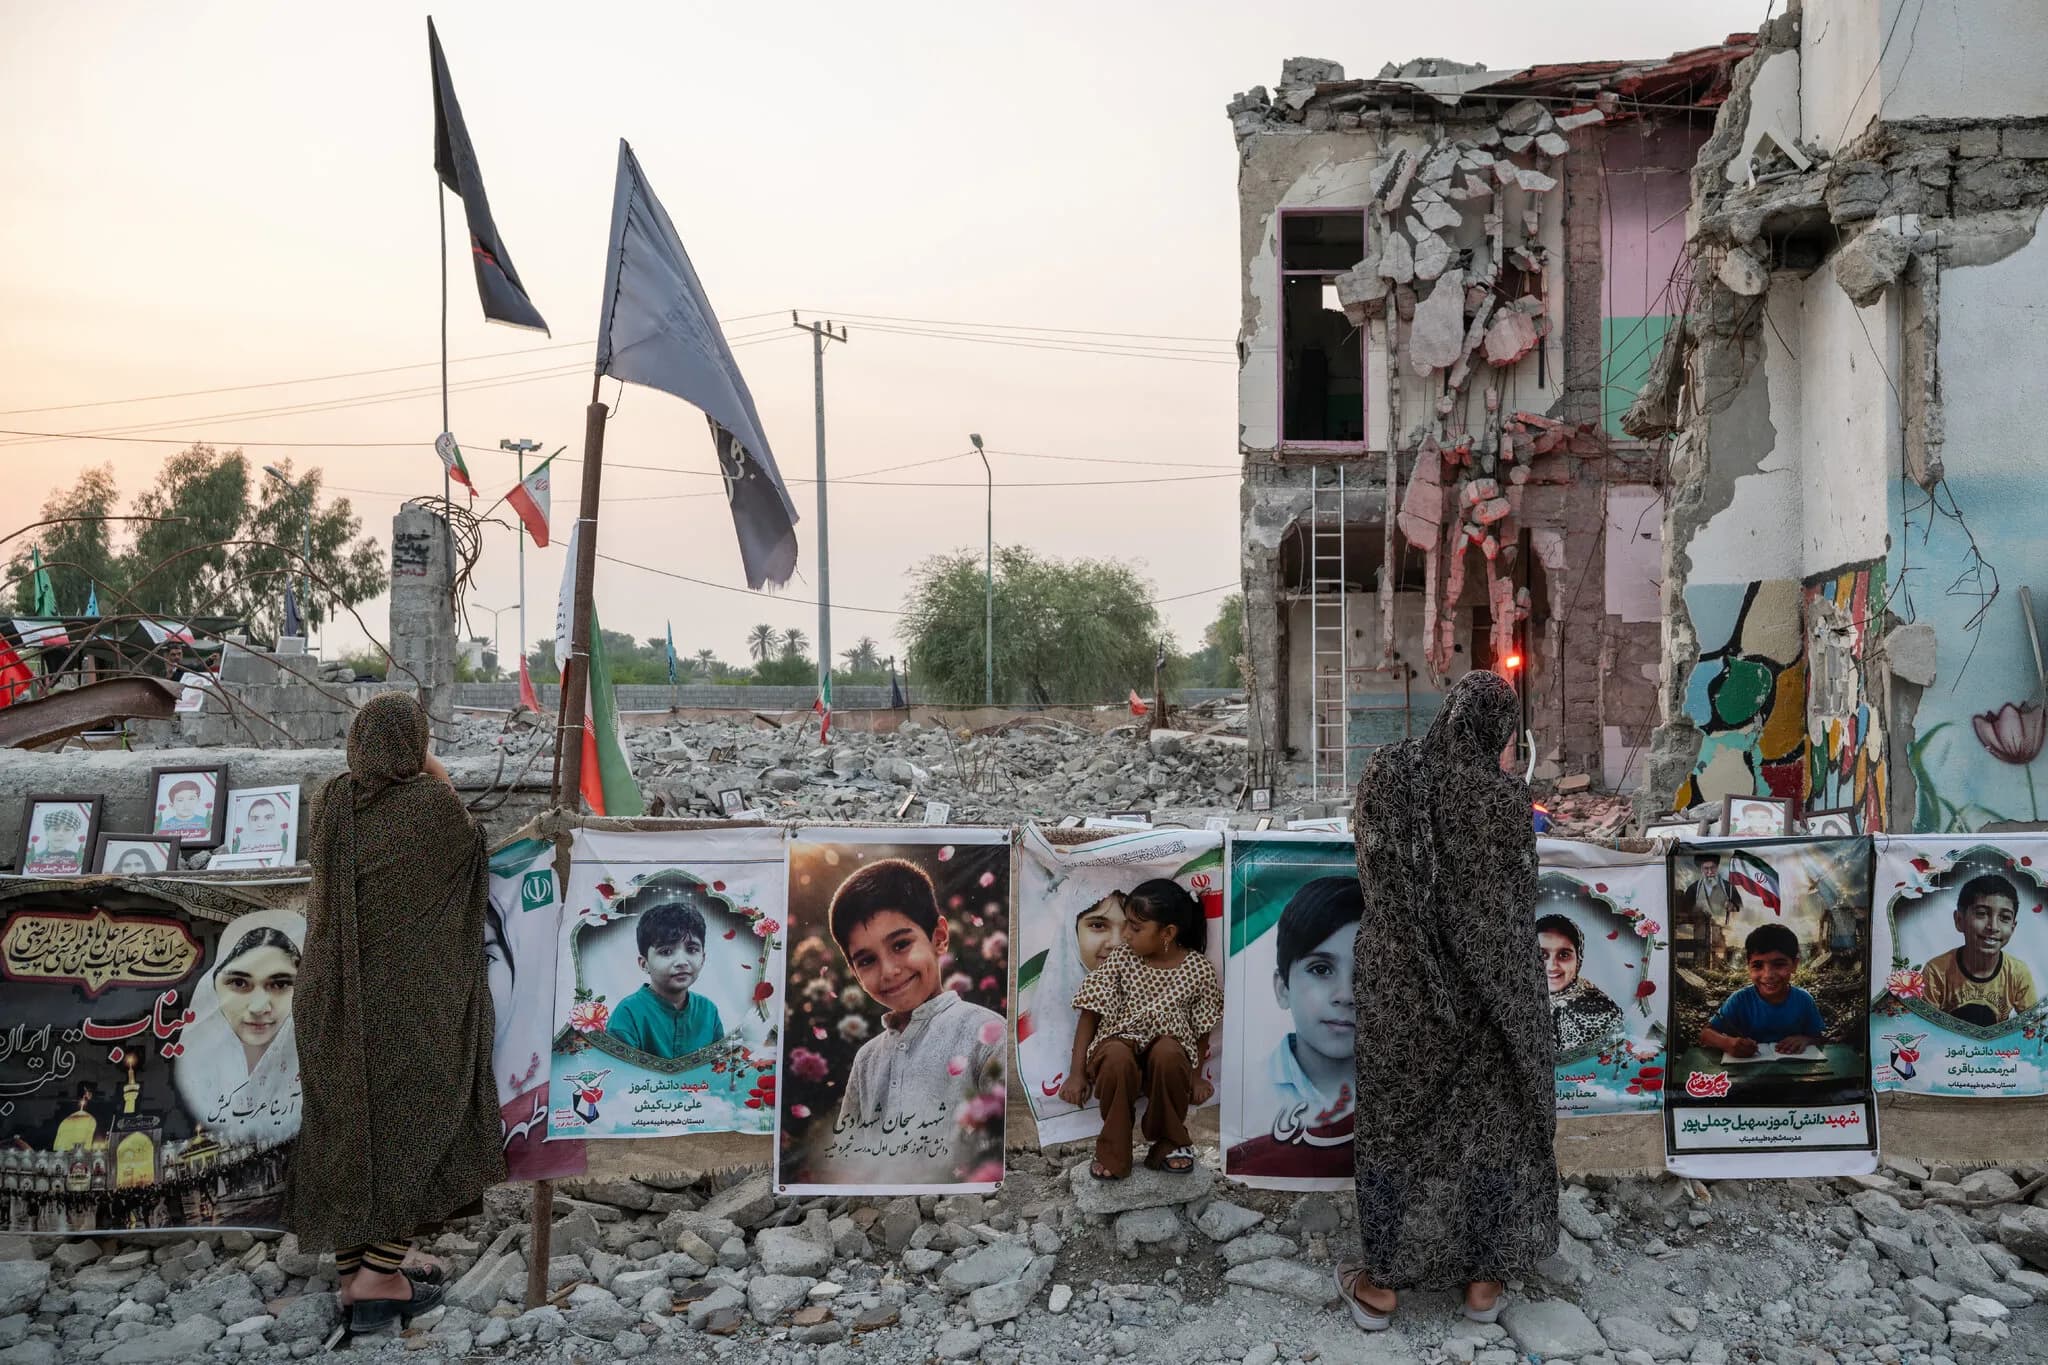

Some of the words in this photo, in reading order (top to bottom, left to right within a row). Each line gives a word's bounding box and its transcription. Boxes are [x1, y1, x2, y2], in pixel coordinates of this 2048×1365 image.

[83, 989, 196, 1063] میناب
[1994, 1046, 2020, 1058] شهید
[1565, 1072, 1597, 1083] شهیده
[1947, 1063, 1975, 1076] باقری
[680, 1080, 709, 1093] شهید
[207, 1080, 249, 1123] کیش
[269, 1091, 302, 1125] آرینا
[684, 1099, 703, 1112] علی
[232, 1102, 267, 1125] عرب
[682, 1118, 705, 1126] دبستان
[832, 1102, 882, 1135] شهدادی
[917, 1102, 947, 1129] شهید
[1824, 1110, 1860, 1128] شهید
[631, 1119, 650, 1127] میناب
[665, 1118, 682, 1127] شجره
[1731, 1114, 1769, 1131] سهیل
[838, 1134, 855, 1157] شجره
[854, 1145, 871, 1154] مدرسه
[872, 1139, 888, 1156] اول
[889, 1139, 913, 1156] کلاس
